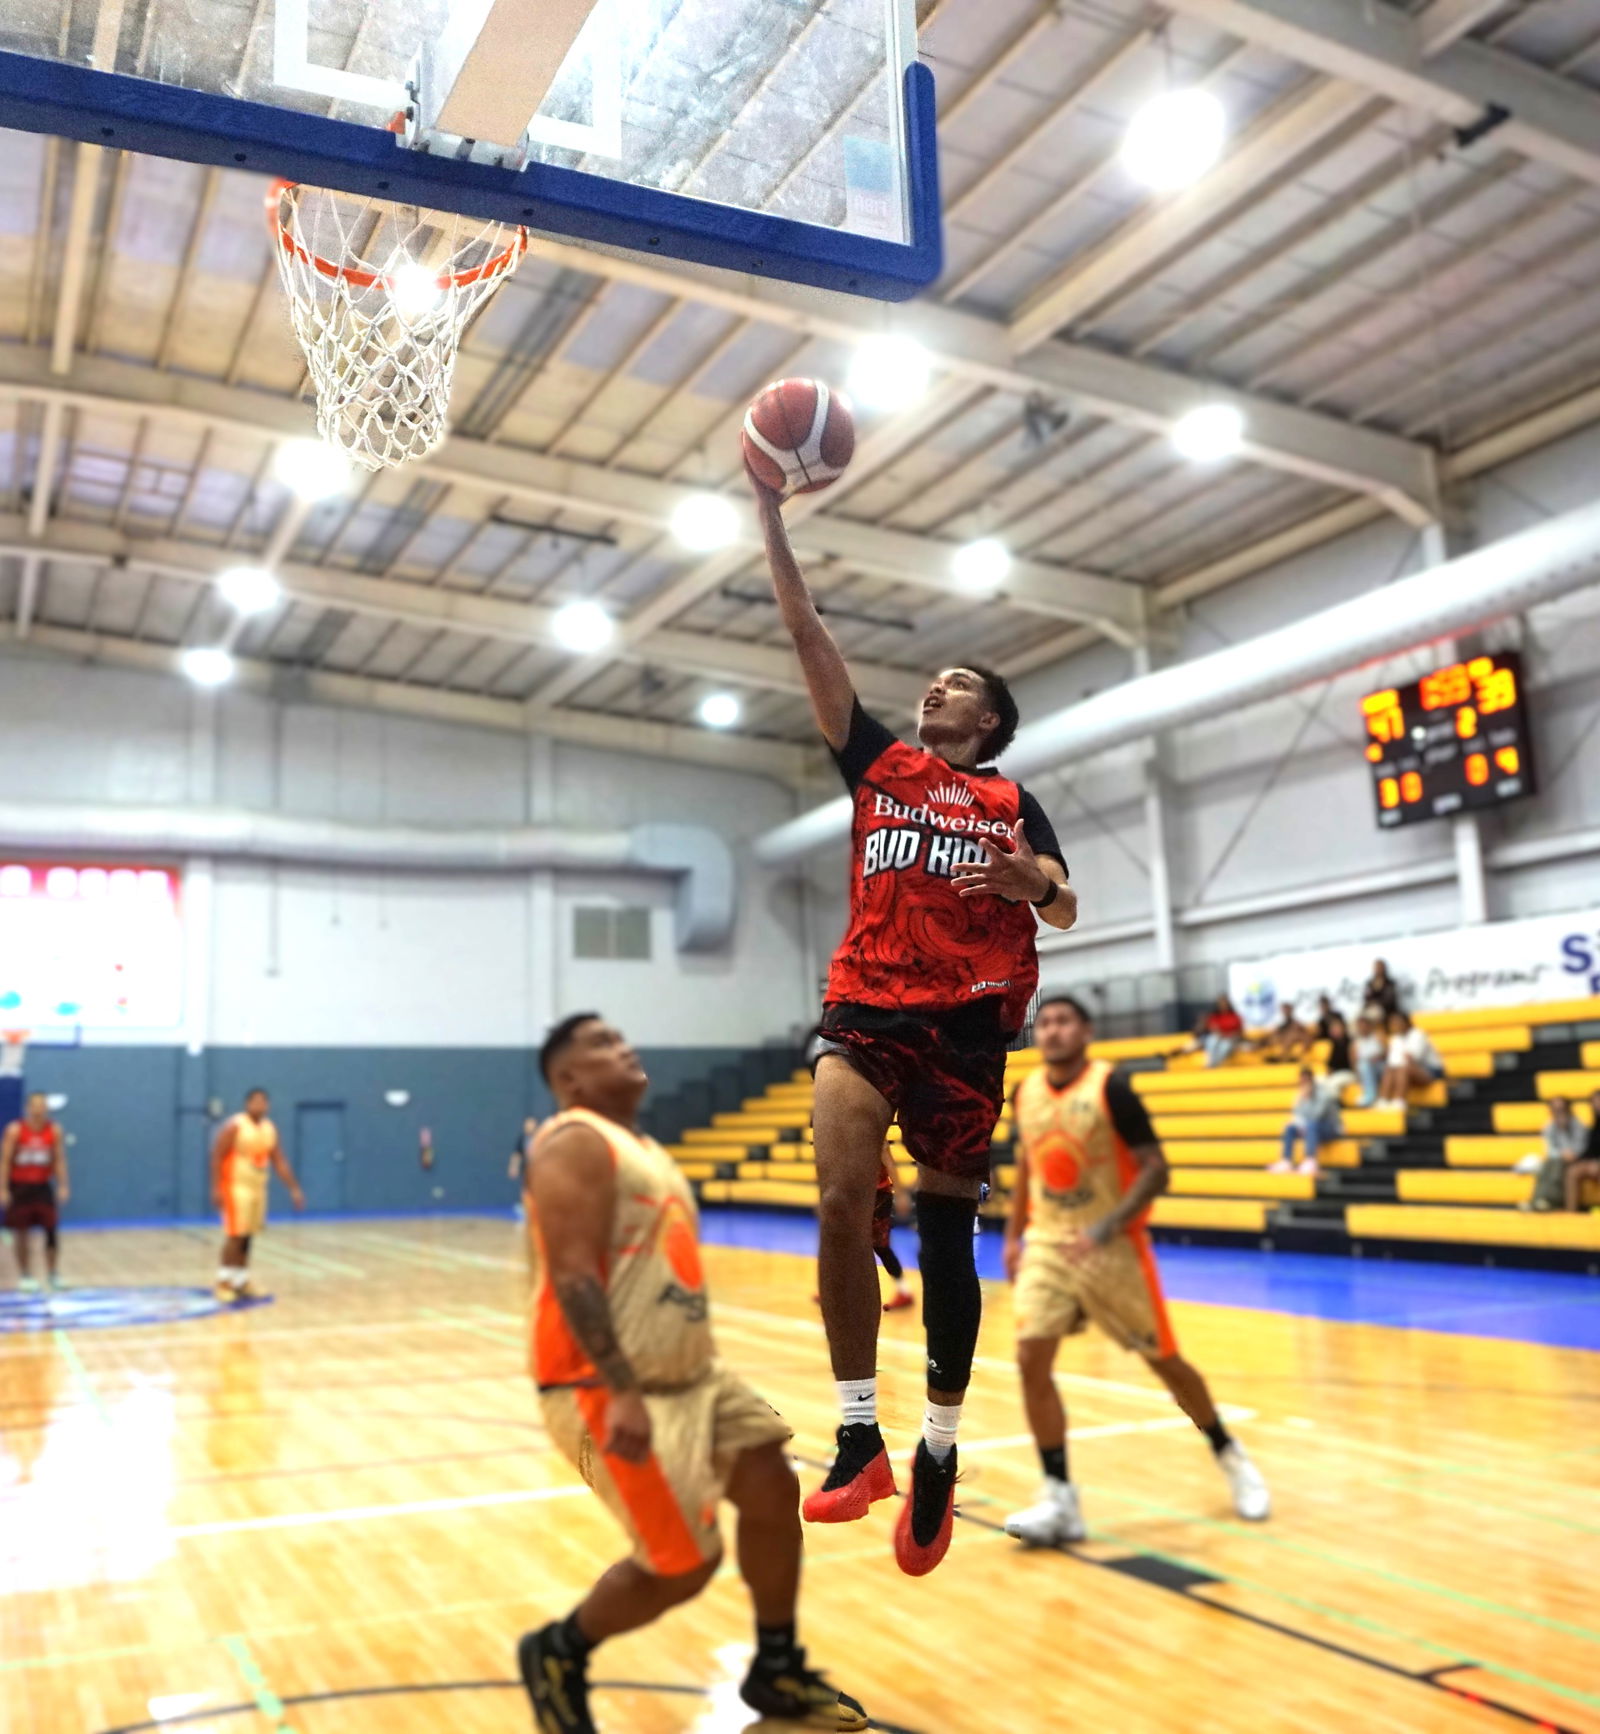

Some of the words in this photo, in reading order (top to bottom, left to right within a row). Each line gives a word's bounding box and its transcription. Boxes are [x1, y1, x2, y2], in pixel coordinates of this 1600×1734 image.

[873, 792, 1016, 840] Budweiser
[863, 828, 921, 878] BUD
[926, 835, 992, 878] KIN
